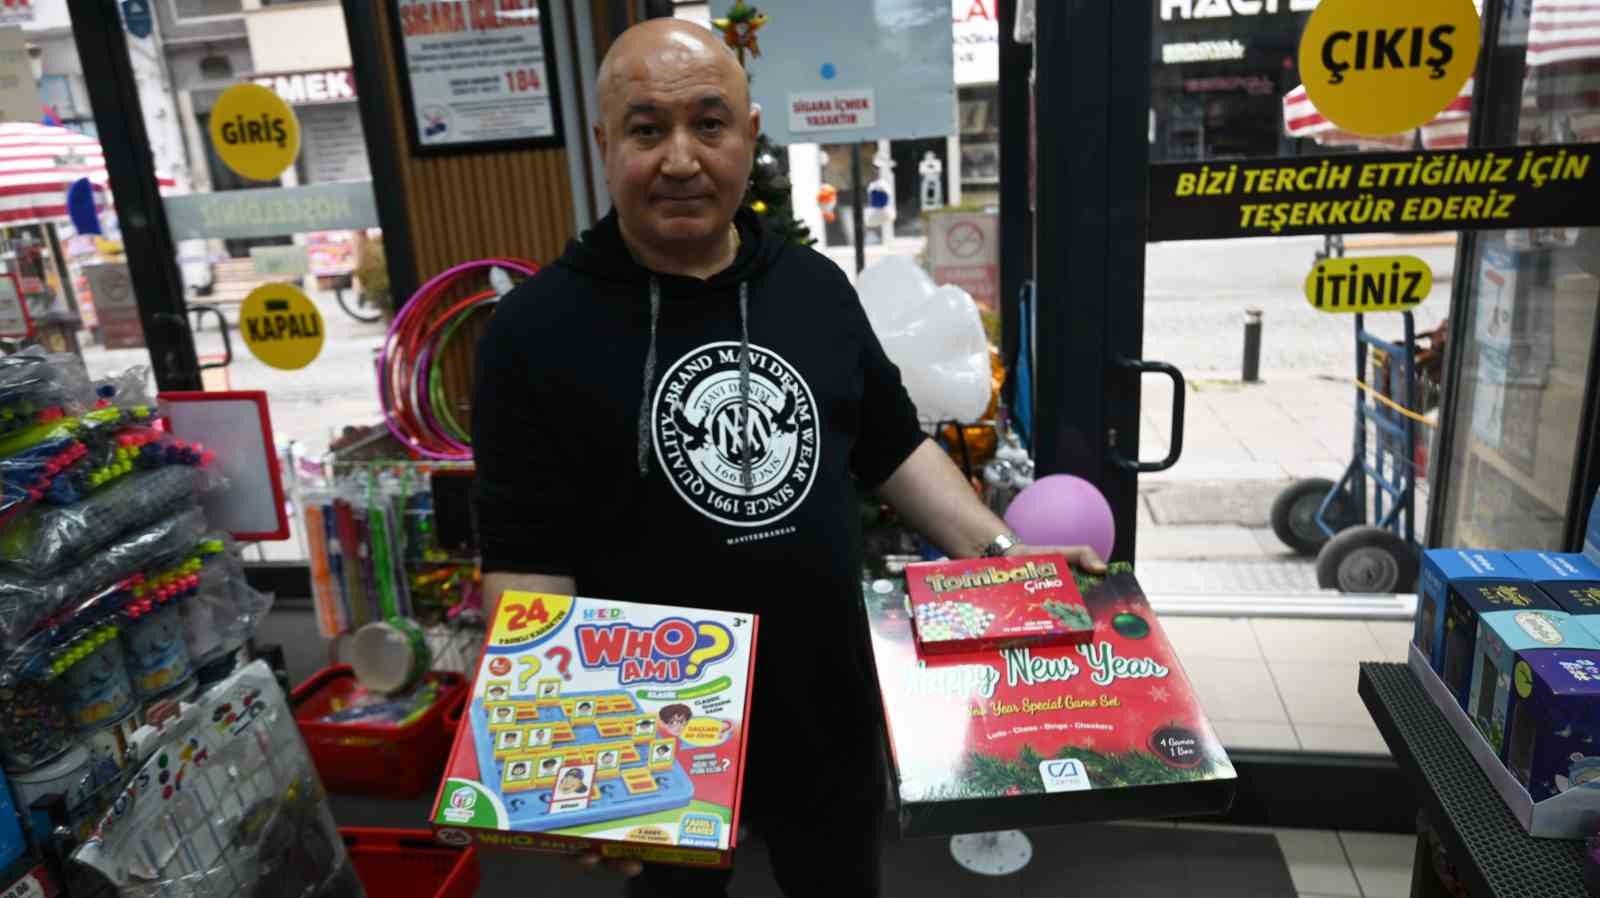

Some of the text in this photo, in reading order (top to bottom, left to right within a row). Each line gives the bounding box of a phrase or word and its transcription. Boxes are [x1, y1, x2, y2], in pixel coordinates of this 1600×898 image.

[1321, 24, 1456, 83] ÇIKIŞ
[254, 71, 353, 103] MEK
[505, 67, 541, 93] 184
[221, 112, 288, 149] GİRİŞ
[1176, 154, 1590, 197] BİZİ TERCİH ETTİĞİNİZ İÇİN
[1240, 188, 1514, 233] TEŞEKKÜR EDERİZ
[1315, 263, 1423, 308] İTİNİZ
[246, 315, 321, 341] KAPALI
[664, 354, 713, 406] BRAND
[768, 361, 812, 423] DENIM
[661, 412, 705, 495] QUALITY
[792, 426, 815, 483] WEAR
[707, 490, 739, 514] 1991
[744, 482, 796, 515] SINCE
[925, 561, 1057, 592] Tombala
[1023, 578, 1064, 593] Çinko
[504, 598, 549, 631] 24
[733, 617, 748, 628] 3+
[1004, 645, 1078, 687] New
[1084, 642, 1168, 686] Year
[991, 697, 1021, 717] Year
[1021, 694, 1063, 715] Special
[1064, 694, 1098, 709] Game
[1099, 691, 1121, 707] Set
[1160, 737, 1167, 747] 4
